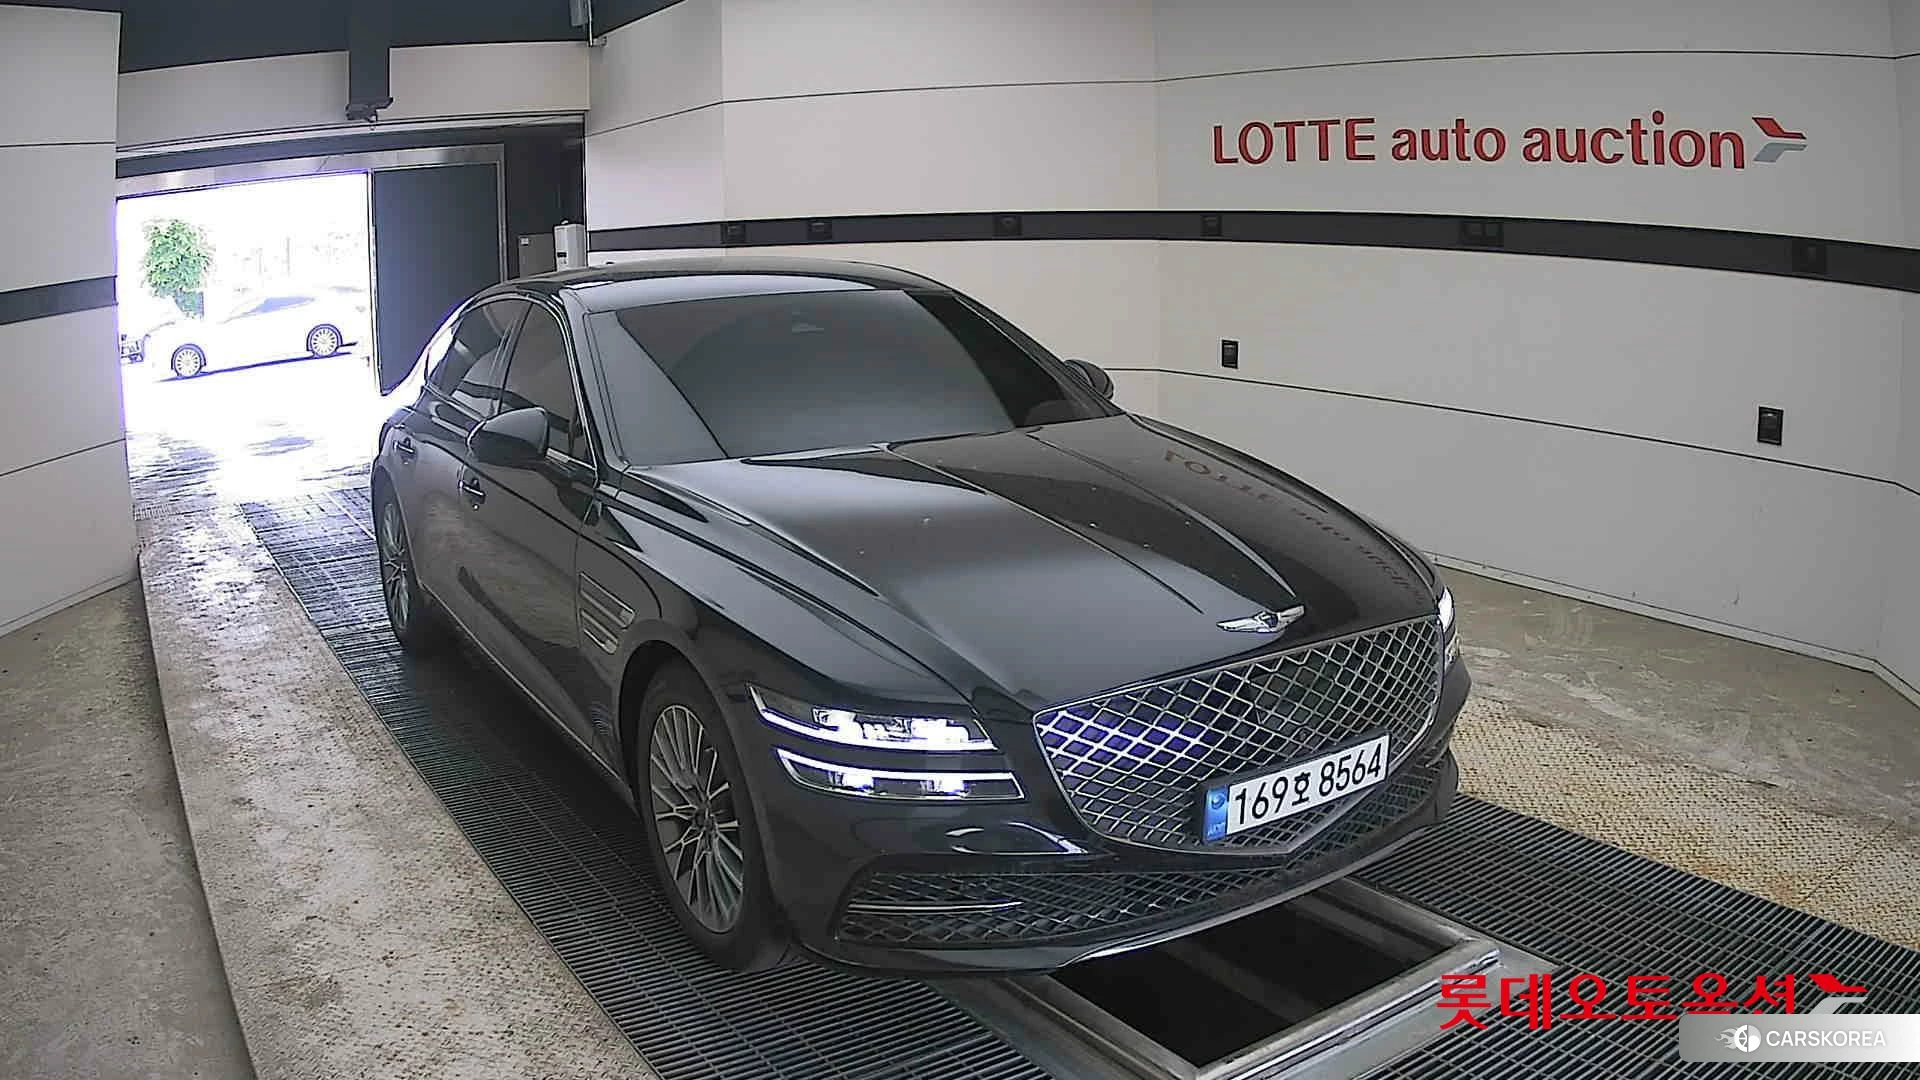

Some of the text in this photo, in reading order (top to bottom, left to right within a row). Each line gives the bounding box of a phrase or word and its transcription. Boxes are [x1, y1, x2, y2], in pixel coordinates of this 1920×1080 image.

[1212, 110, 1745, 168] LOTTE auto auction
[1318, 743, 1383, 797] 8564
